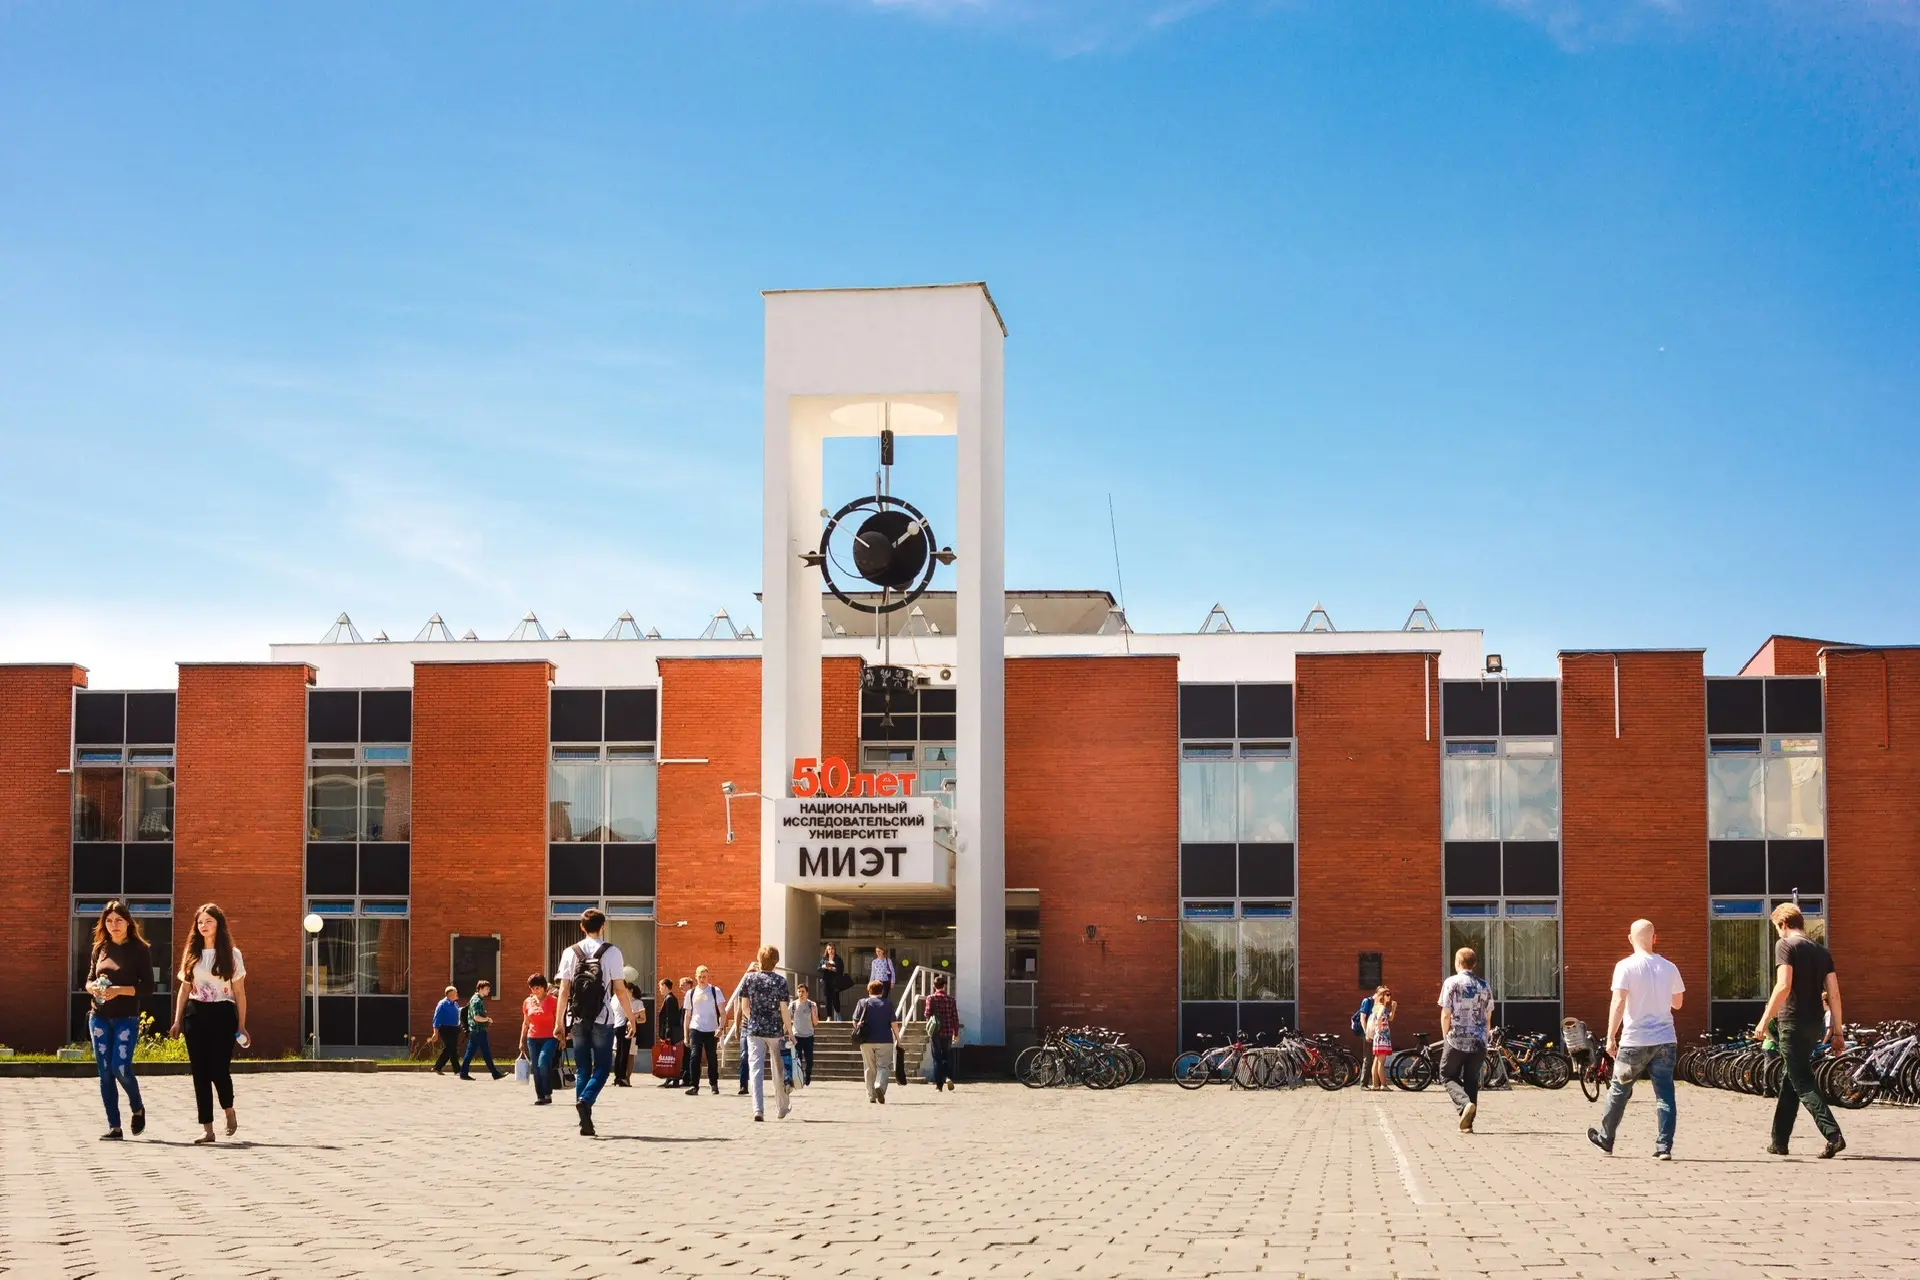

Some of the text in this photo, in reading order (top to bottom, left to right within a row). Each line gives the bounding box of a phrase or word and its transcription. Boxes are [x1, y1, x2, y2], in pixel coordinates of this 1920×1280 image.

[799, 801, 908, 815] НАЦИОНАЛЬНЫЙ
[783, 815, 925, 829] ИССЛЕДОВАТЕЛЬСКИЙ
[809, 829, 899, 840] УНИВЕРСИТЕТ
[799, 847, 908, 877] МИЭТ
